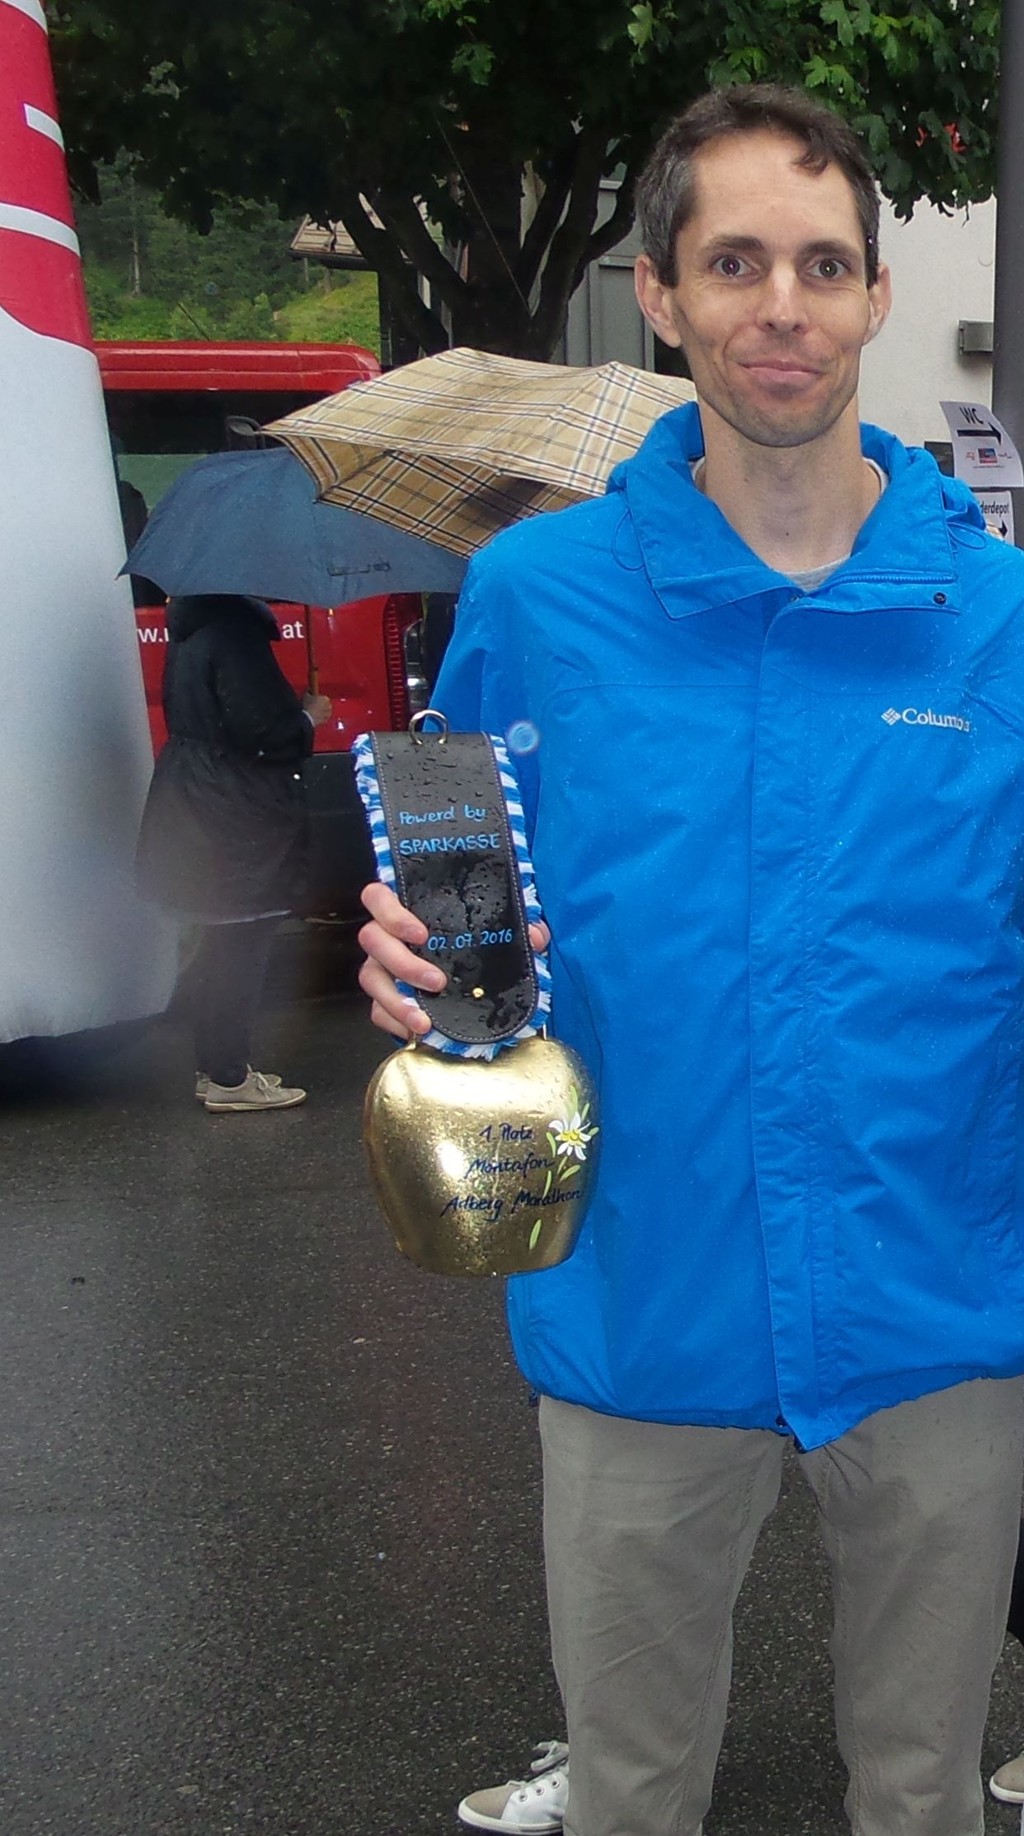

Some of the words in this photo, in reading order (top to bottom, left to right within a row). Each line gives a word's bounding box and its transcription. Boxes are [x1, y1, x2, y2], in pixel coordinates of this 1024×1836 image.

[959, 406, 984, 425] WC
[980, 500, 1010, 518] derdepot
[400, 805, 454, 825] Powerd
[464, 804, 486, 824] by
[400, 833, 500, 855] SPARKASSE
[499, 1122, 534, 1141] Platz
[464, 1151, 556, 1178] Montafon
[510, 1188, 582, 1214] Marathon
